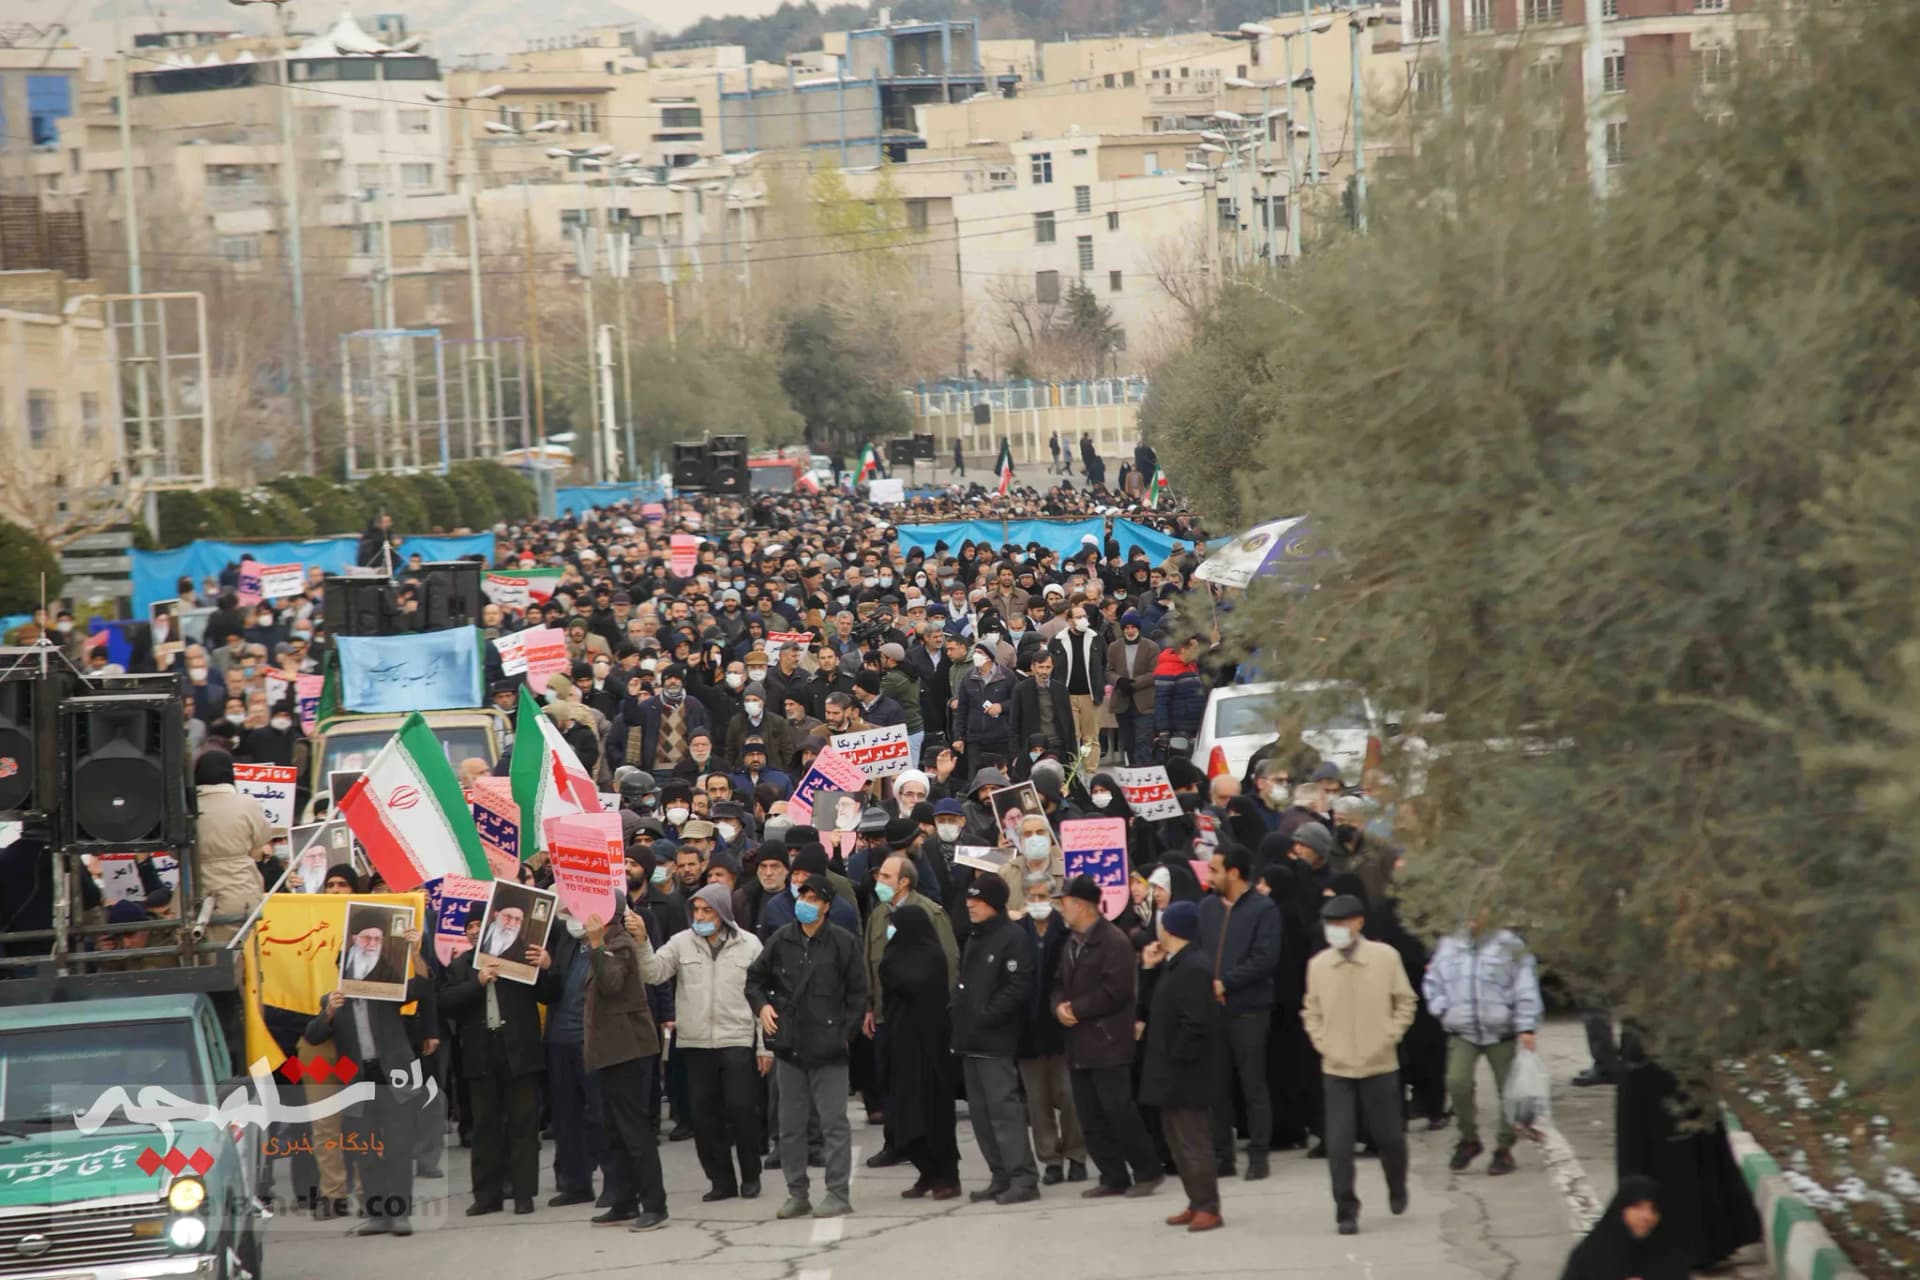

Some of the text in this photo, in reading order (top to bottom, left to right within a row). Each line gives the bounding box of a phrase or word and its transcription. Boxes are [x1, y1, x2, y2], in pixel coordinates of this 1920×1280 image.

[836, 732, 903, 750] مرگ بر آمریکا
[875, 749, 884, 761] بر
[885, 744, 908, 757] مرگ
[886, 760, 908, 770] مرگ
[1069, 850, 1120, 870] مرگ بر
